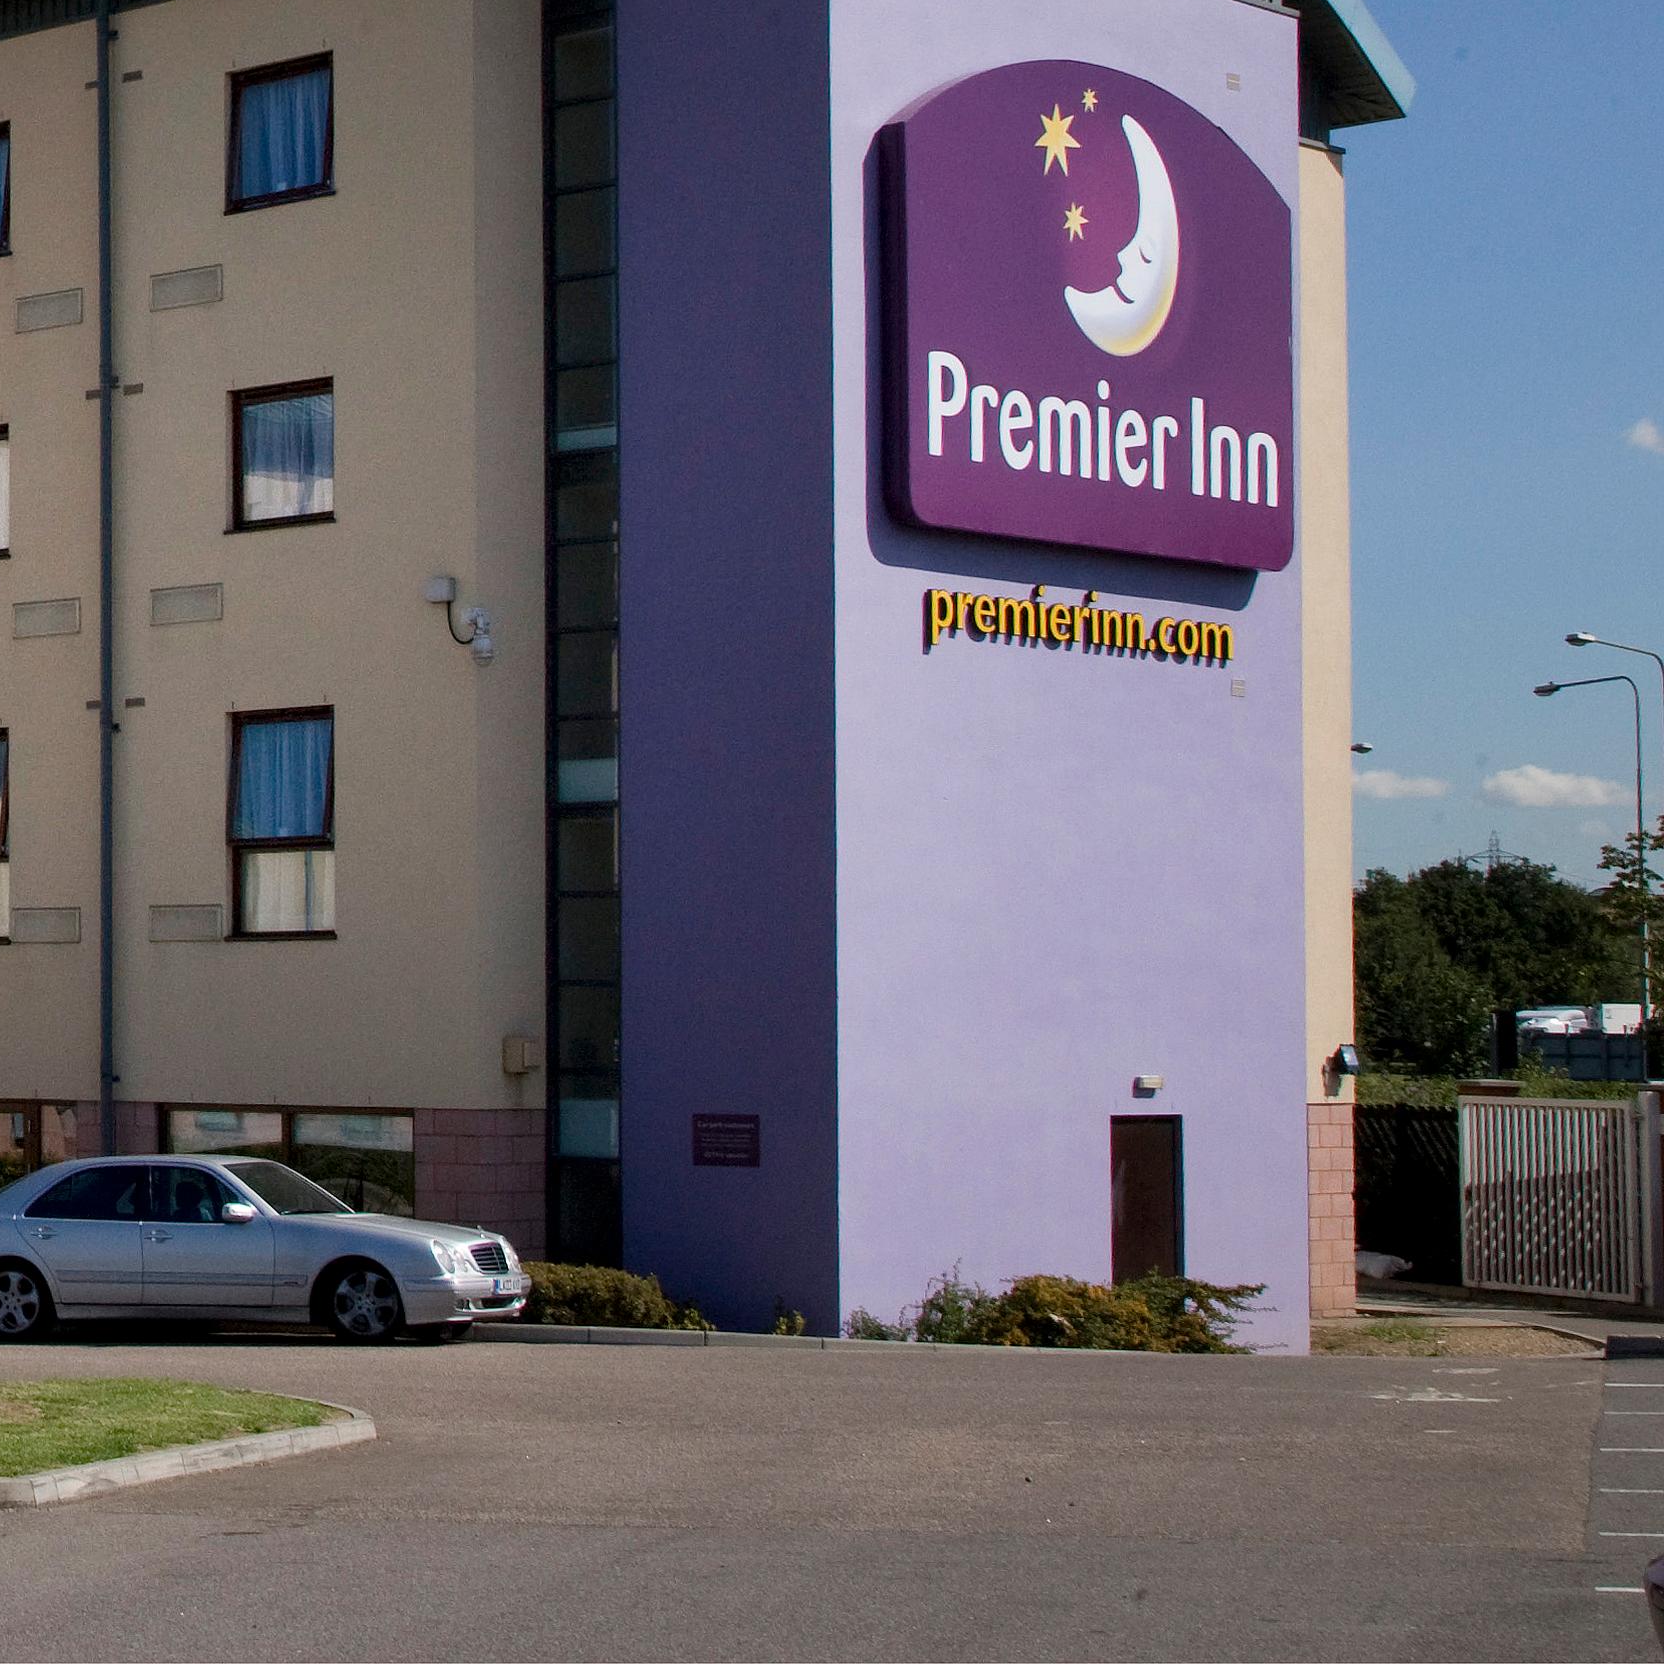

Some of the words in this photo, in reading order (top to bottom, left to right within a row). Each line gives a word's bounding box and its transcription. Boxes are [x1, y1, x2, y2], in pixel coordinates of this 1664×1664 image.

[928, 350, 1178, 491] Premier
[1190, 397, 1279, 508] Inn
[929, 584, 1234, 661] premierinn.com
